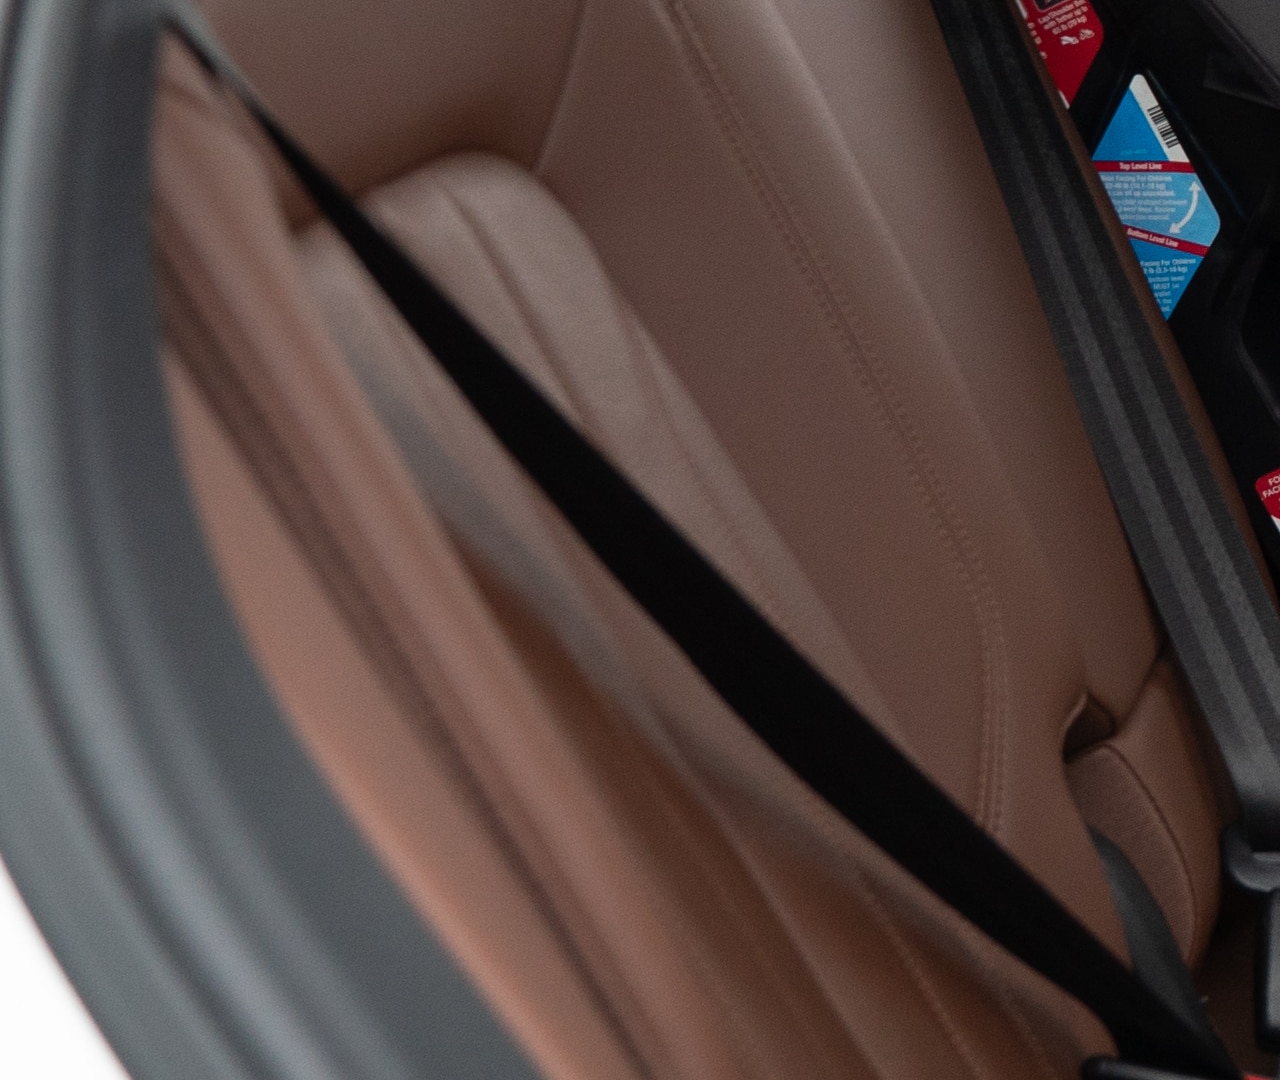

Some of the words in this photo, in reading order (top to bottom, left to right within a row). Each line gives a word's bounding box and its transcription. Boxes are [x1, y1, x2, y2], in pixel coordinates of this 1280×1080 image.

[1119, 162, 1131, 171] Top
[1131, 162, 1149, 170] Level
[1149, 162, 1163, 170] Line
[1126, 227, 1149, 240] Bottom
[1148, 233, 1166, 245] Level
[1165, 237, 1180, 248] Line
